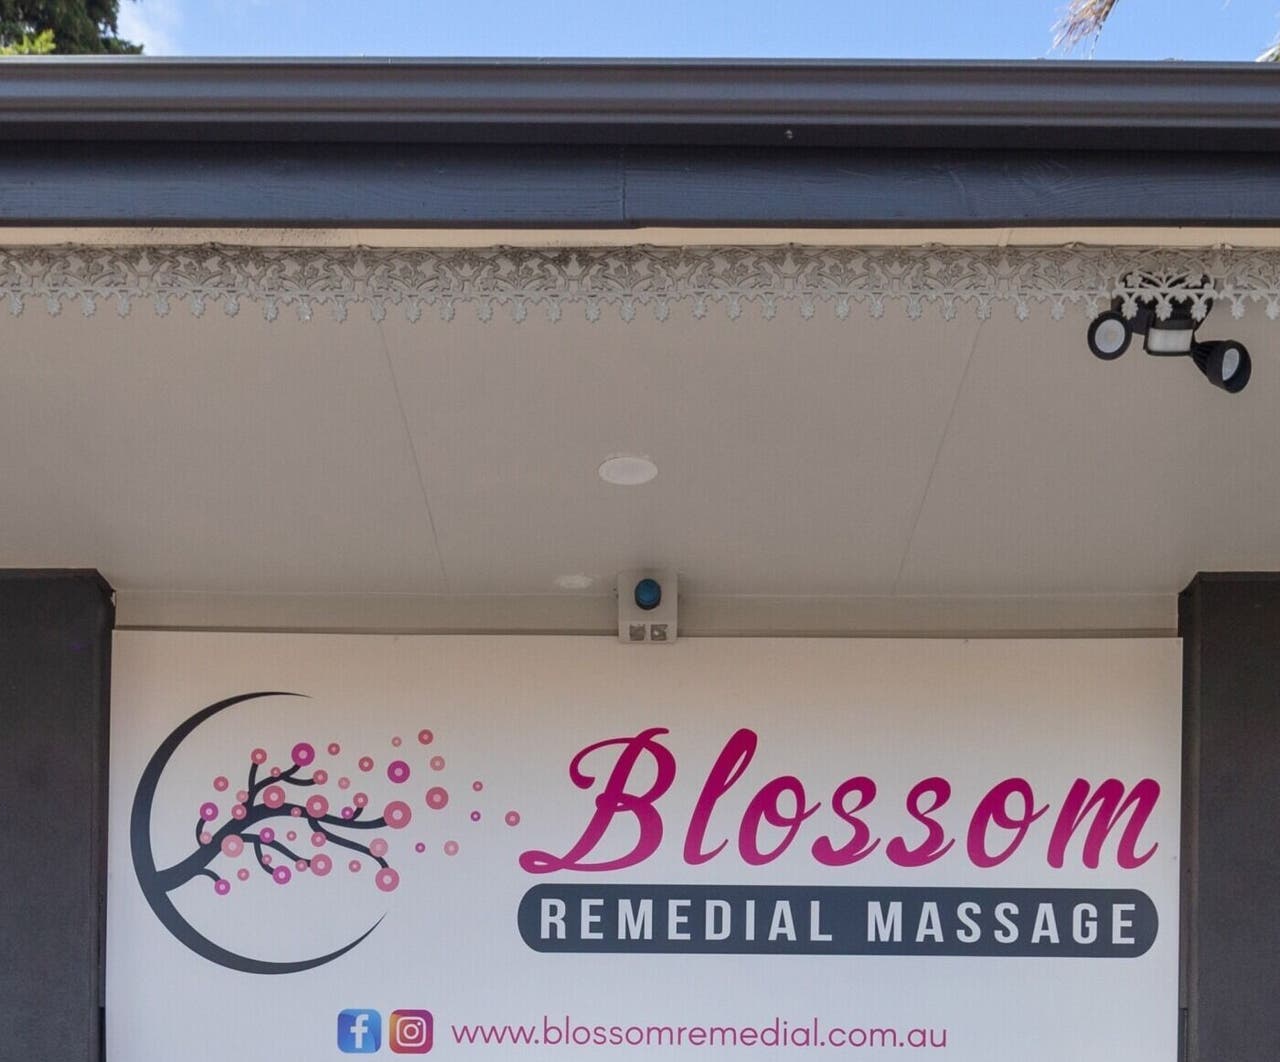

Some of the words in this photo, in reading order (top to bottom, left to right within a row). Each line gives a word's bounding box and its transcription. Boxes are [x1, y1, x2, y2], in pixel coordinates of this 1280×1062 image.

[519, 726, 1161, 875] Blossom
[540, 898, 833, 941] REMEDIAL
[867, 901, 1136, 944] MASSAGE
[453, 1016, 948, 1048] www.blossomremedial.com.au
